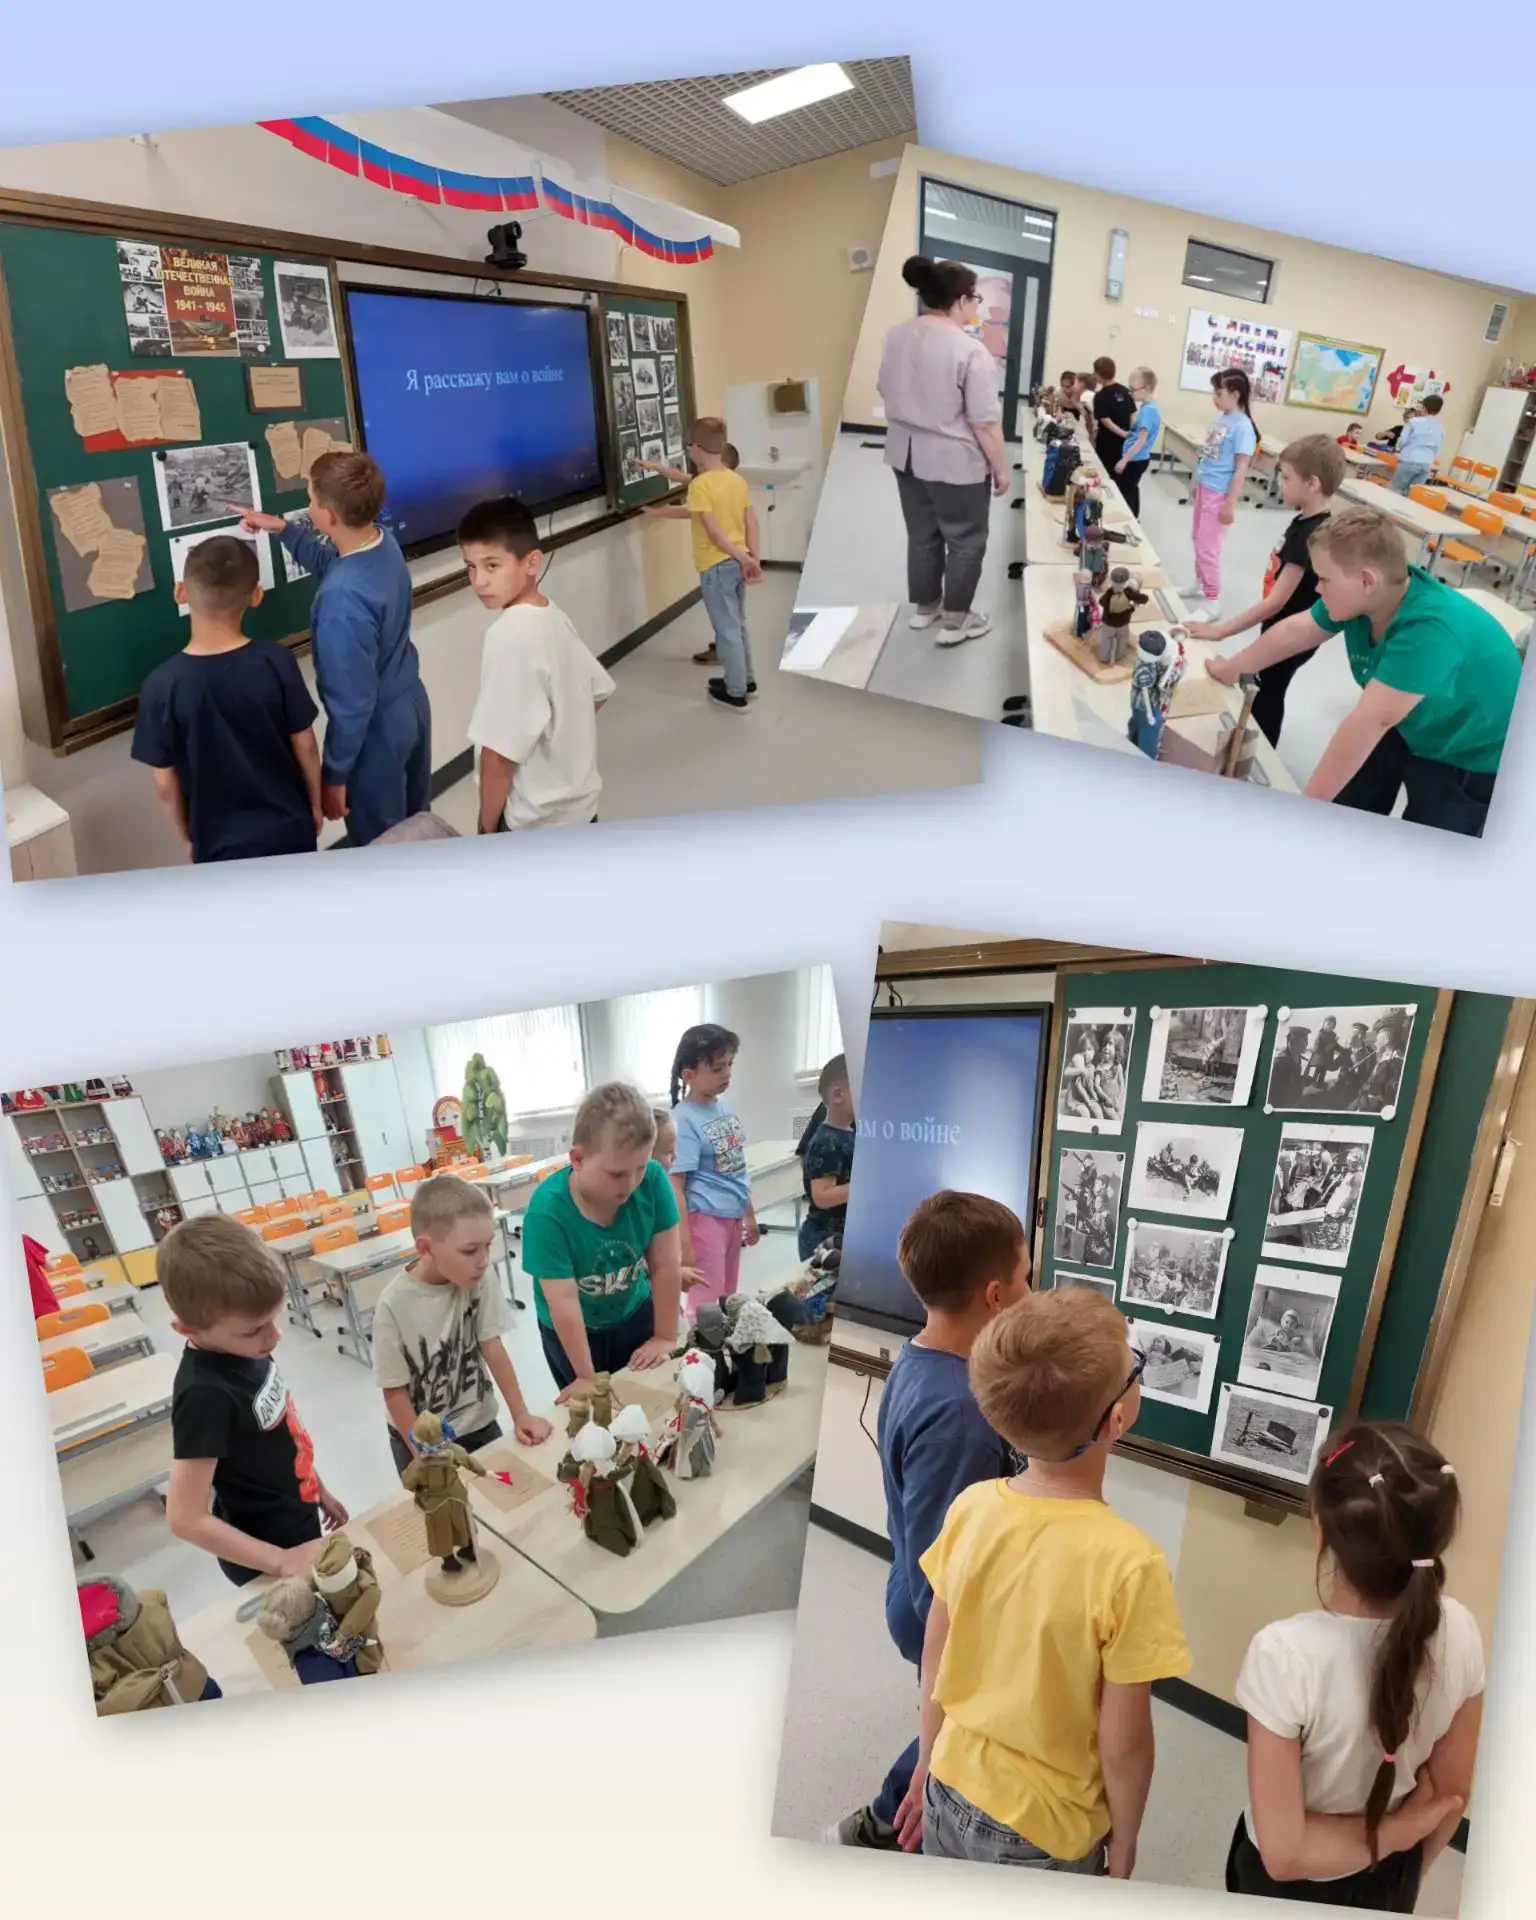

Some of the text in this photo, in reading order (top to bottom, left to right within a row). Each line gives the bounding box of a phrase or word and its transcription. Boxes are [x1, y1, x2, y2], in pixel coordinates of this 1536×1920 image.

[173, 257, 218, 271] ВЕЛИКАЯ
[157, 267, 235, 286] ОТЕЧЕСТВЕННАЯ
[183, 285, 216, 298] ВОЙНА
[174, 299, 196, 311] 1941
[205, 301, 227, 313] 1945
[406, 364, 564, 396] Я расскажу вам о войне
[856, 1116, 961, 1145] ам о войне
